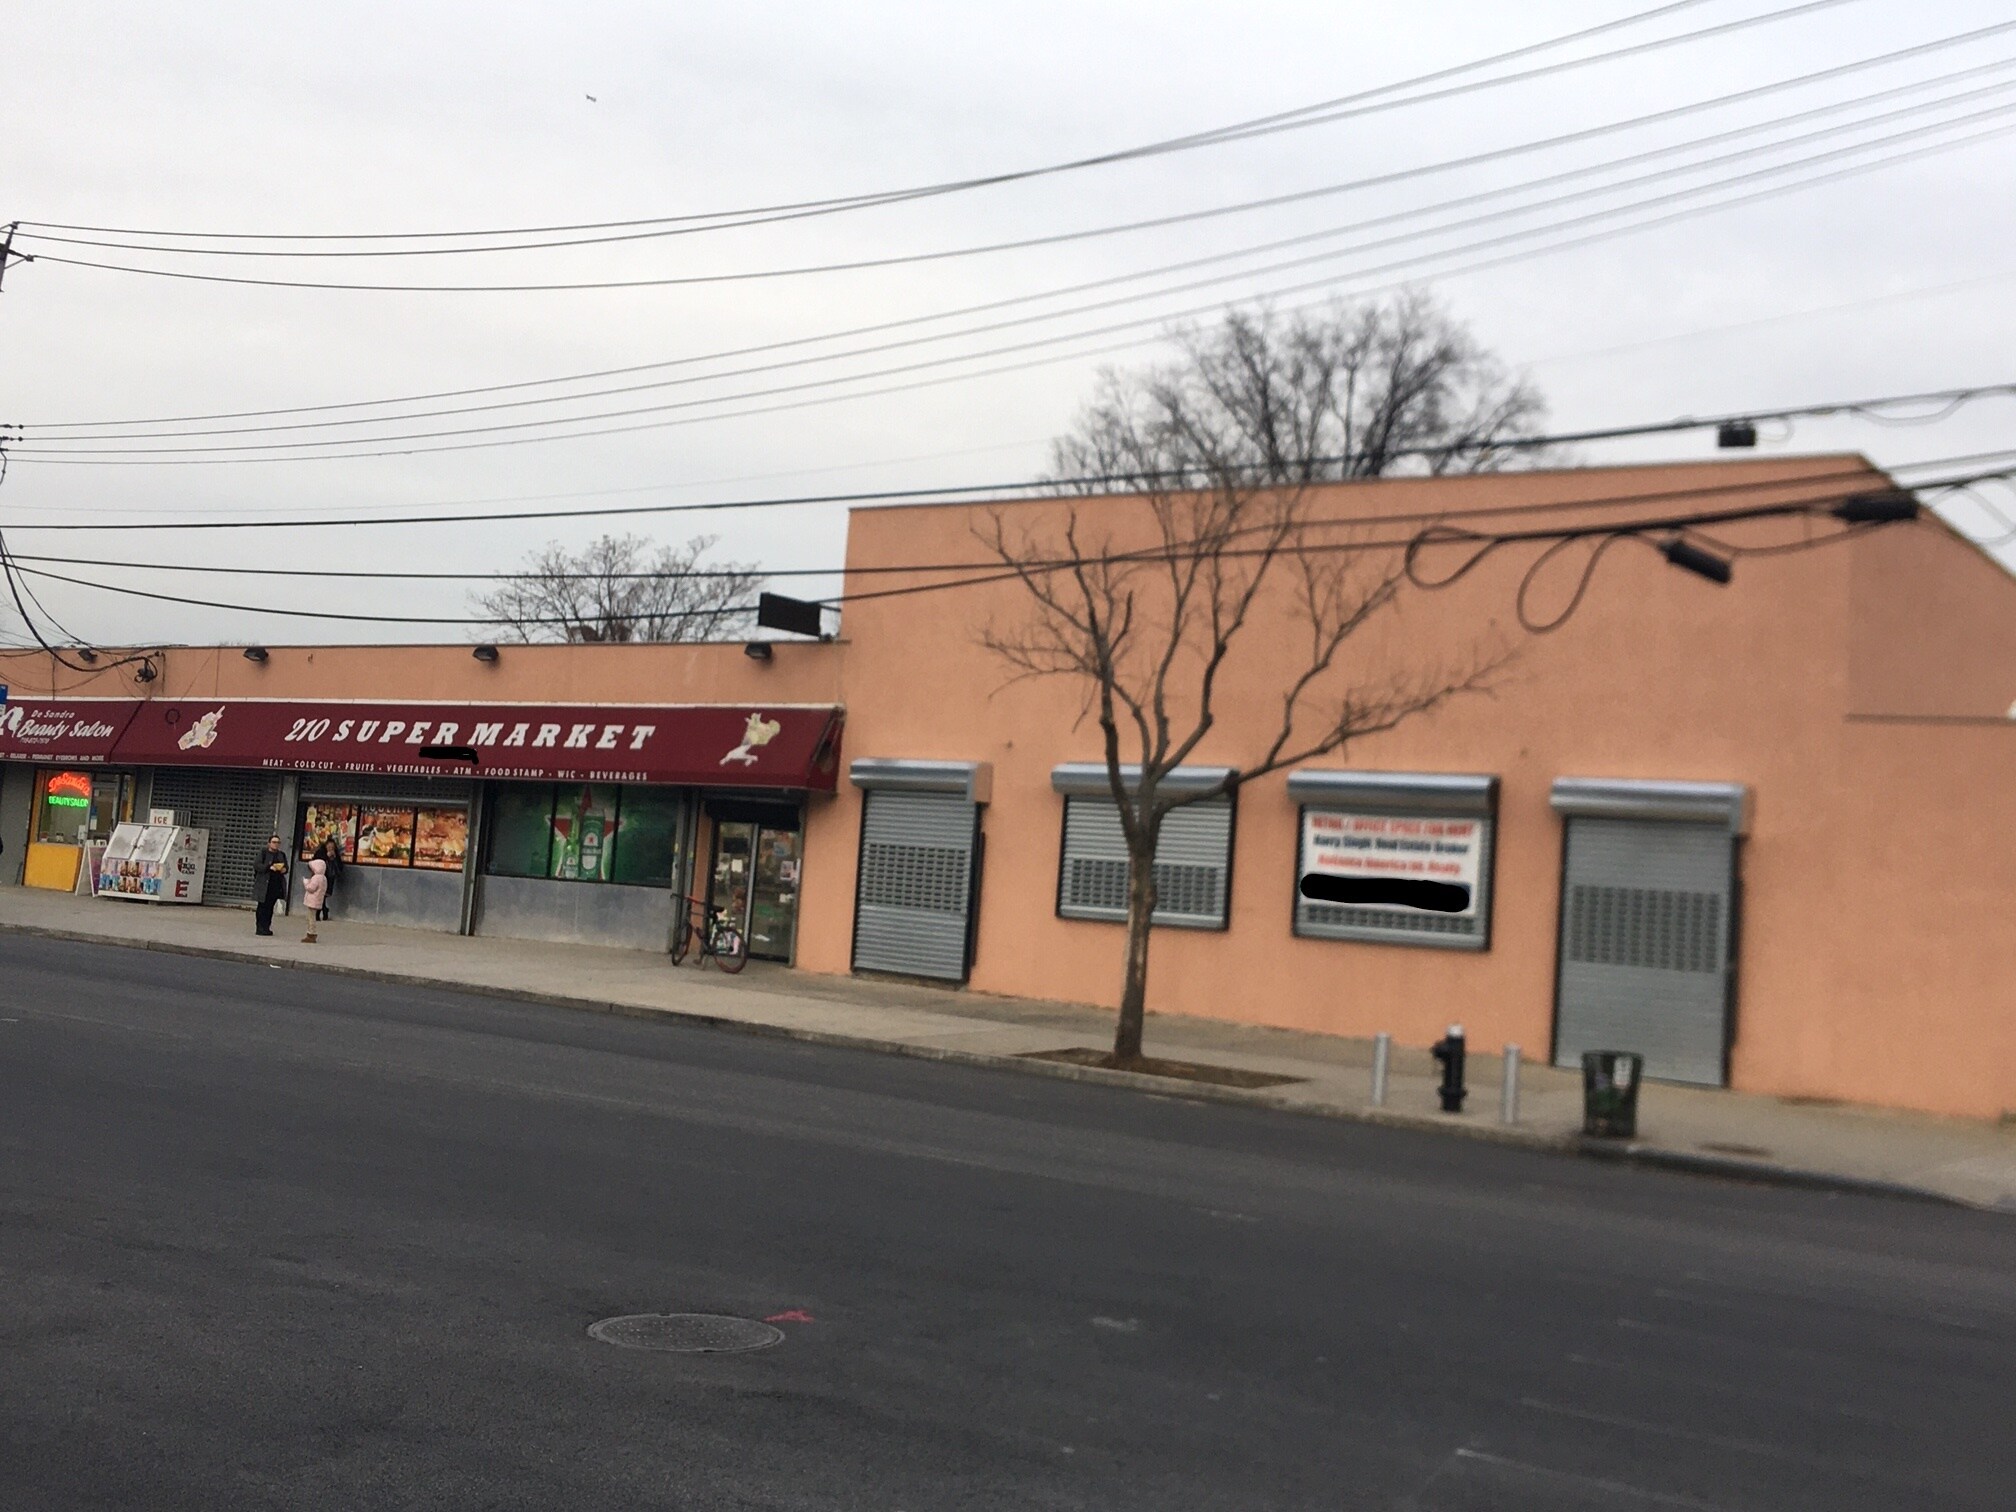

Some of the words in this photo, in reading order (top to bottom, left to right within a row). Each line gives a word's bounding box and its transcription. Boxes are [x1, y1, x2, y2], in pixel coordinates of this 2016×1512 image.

[17, 719, 70, 740] Beauty
[69, 720, 114, 737] Salon
[284, 718, 331, 742] 210
[332, 720, 460, 745] SUPER
[467, 722, 656, 751] MARKET
[262, 758, 284, 767] MEAT
[294, 759, 317, 769] COLD
[318, 761, 334, 769] CUT
[344, 762, 375, 771] FRUITS
[386, 764, 441, 775] VEGETABLES
[453, 766, 472, 775] ATM
[485, 767, 511, 776] FOOD
[513, 767, 544, 777] STAMP
[557, 770, 576, 779] WIC
[590, 771, 648, 781] BEVERAGES
[153, 815, 168, 825] ICE
